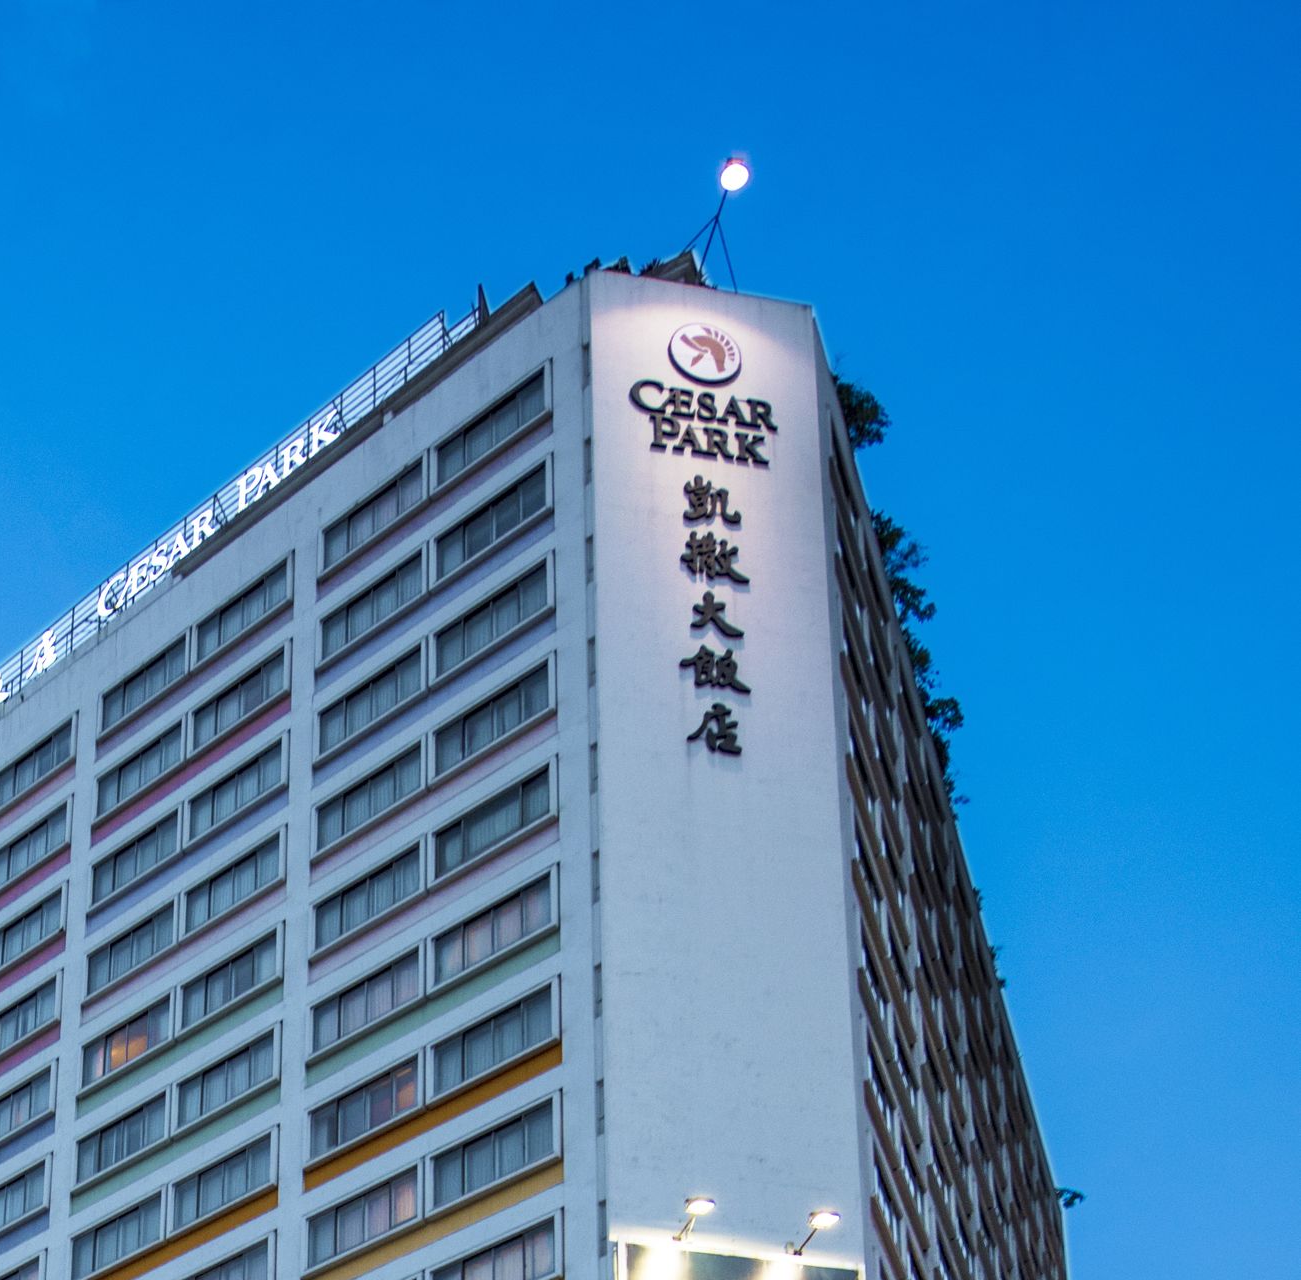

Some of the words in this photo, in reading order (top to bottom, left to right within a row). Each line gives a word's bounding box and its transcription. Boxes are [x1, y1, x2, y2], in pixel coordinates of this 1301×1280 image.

[236, 409, 341, 514] PARK
[649, 414, 770, 466] PARK
[680, 474, 751, 756] 凱撒大飯店
